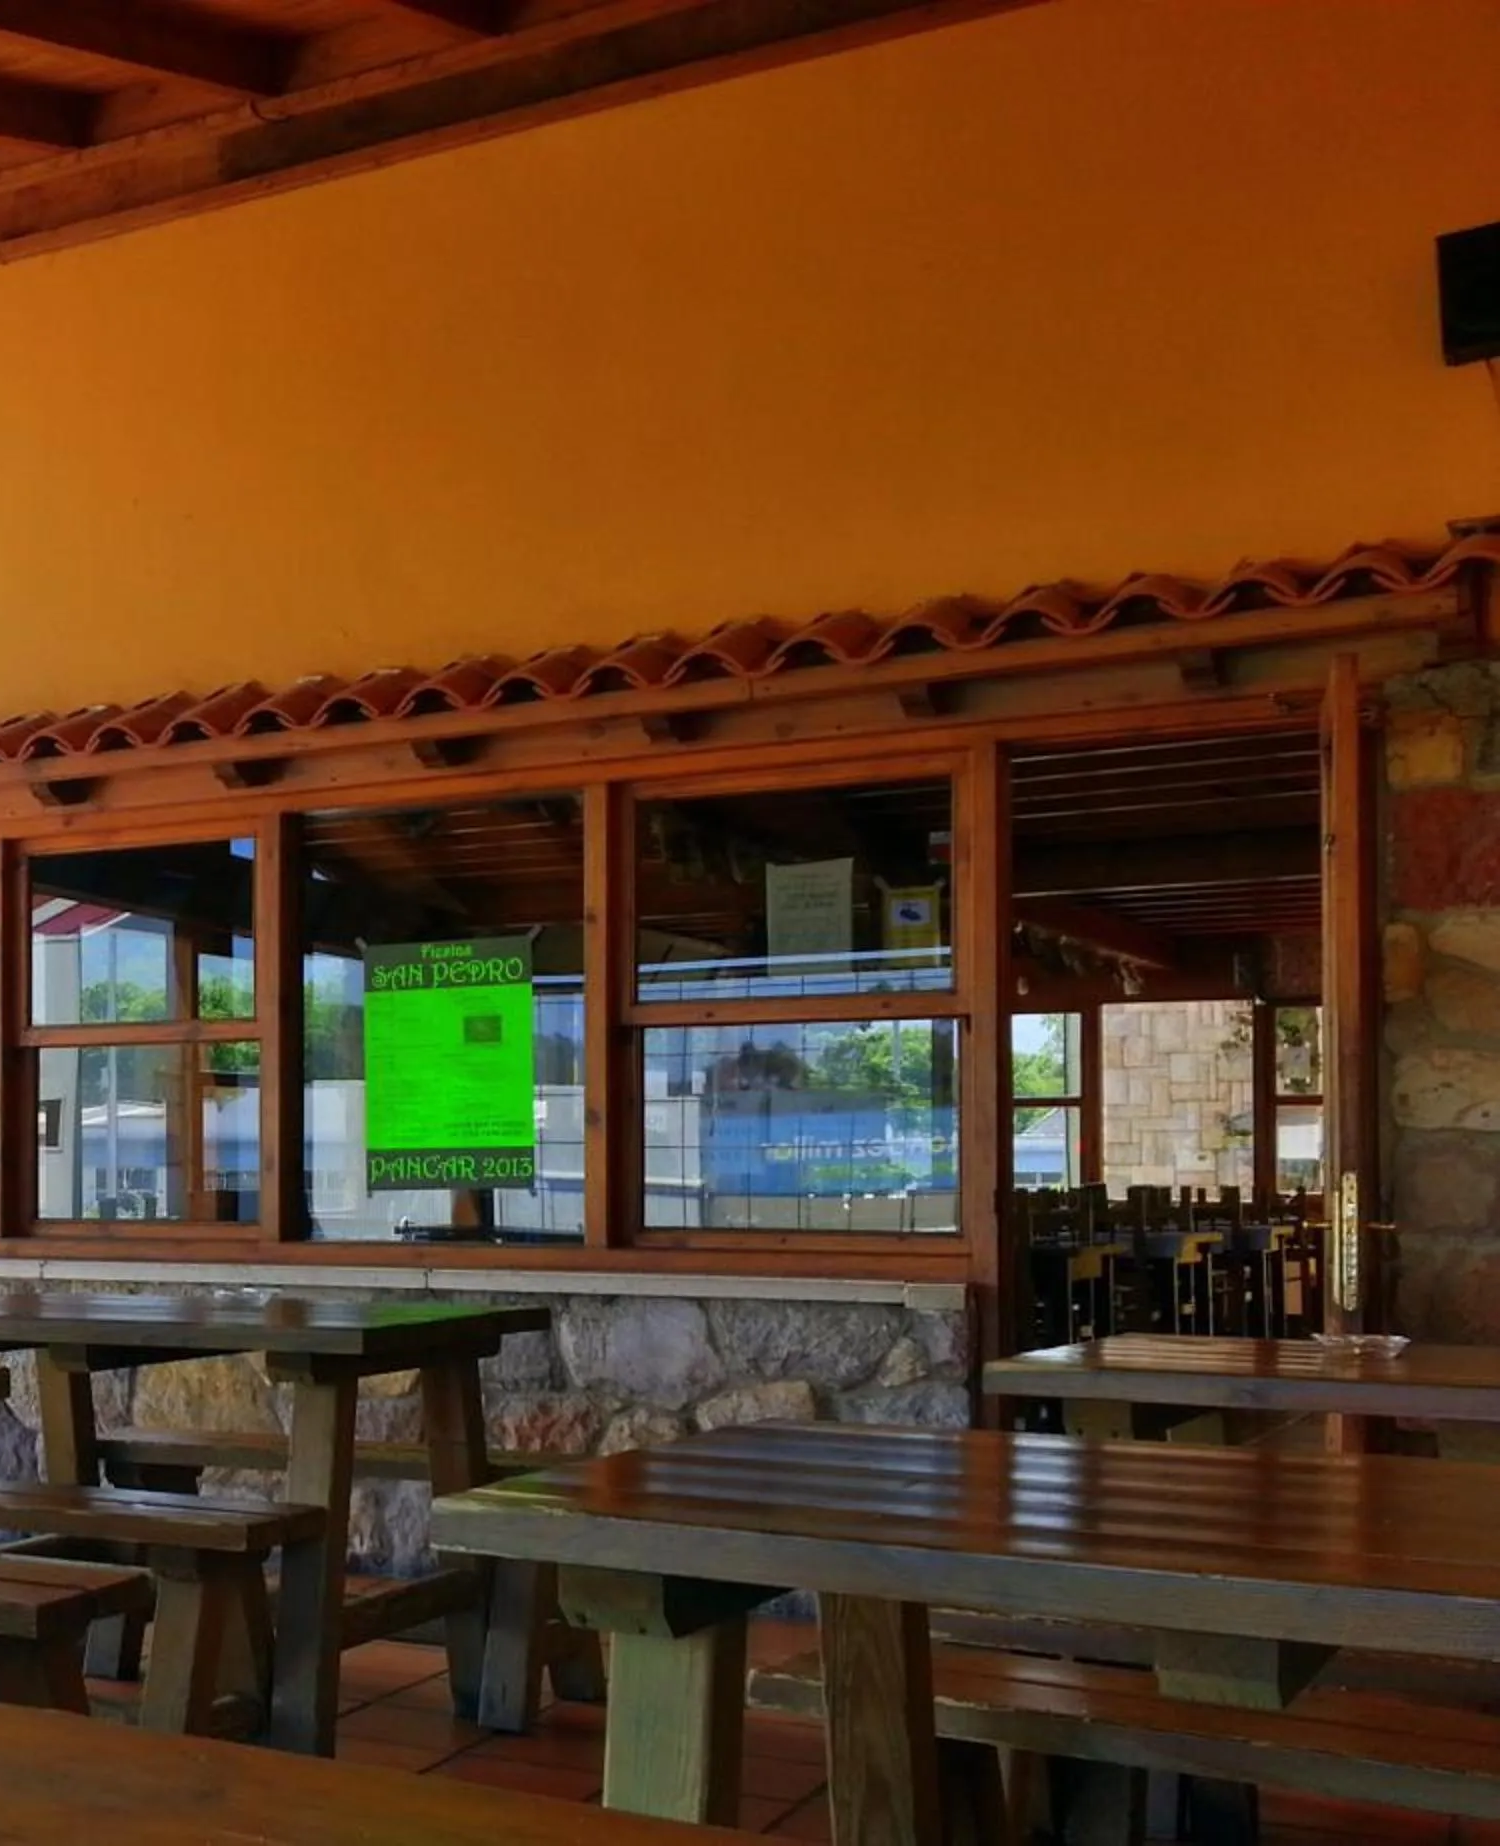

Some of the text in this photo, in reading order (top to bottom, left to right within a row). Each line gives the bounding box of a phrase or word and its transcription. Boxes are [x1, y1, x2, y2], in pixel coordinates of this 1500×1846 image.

[371, 956, 524, 990] SAN PEDRO
[370, 1154, 478, 1184] PANCAR
